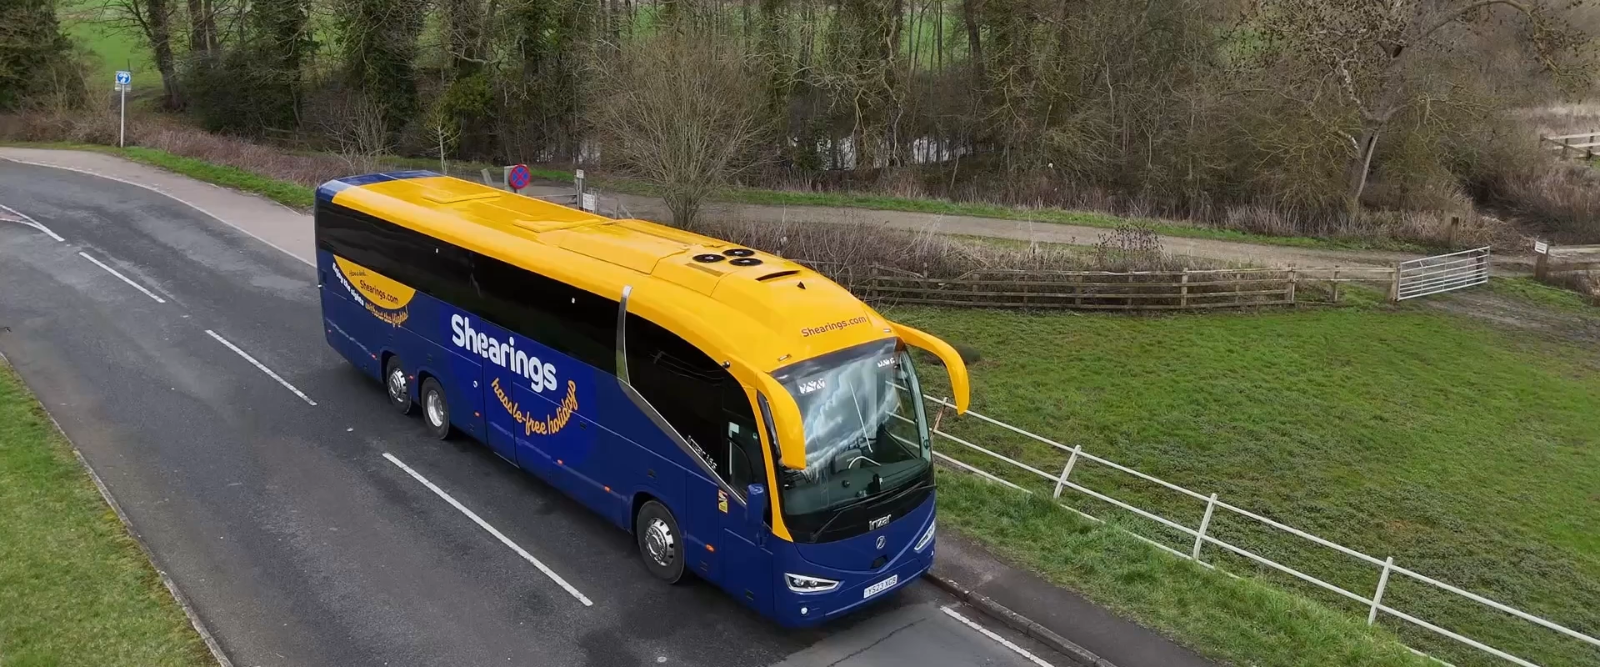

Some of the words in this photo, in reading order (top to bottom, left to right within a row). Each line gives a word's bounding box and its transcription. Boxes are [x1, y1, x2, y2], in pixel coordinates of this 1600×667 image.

[360, 280, 399, 305] Shearings.com
[801, 316, 867, 338] Shearings.com
[451, 313, 558, 393] Shearings
[491, 378, 548, 436] hassle-free
